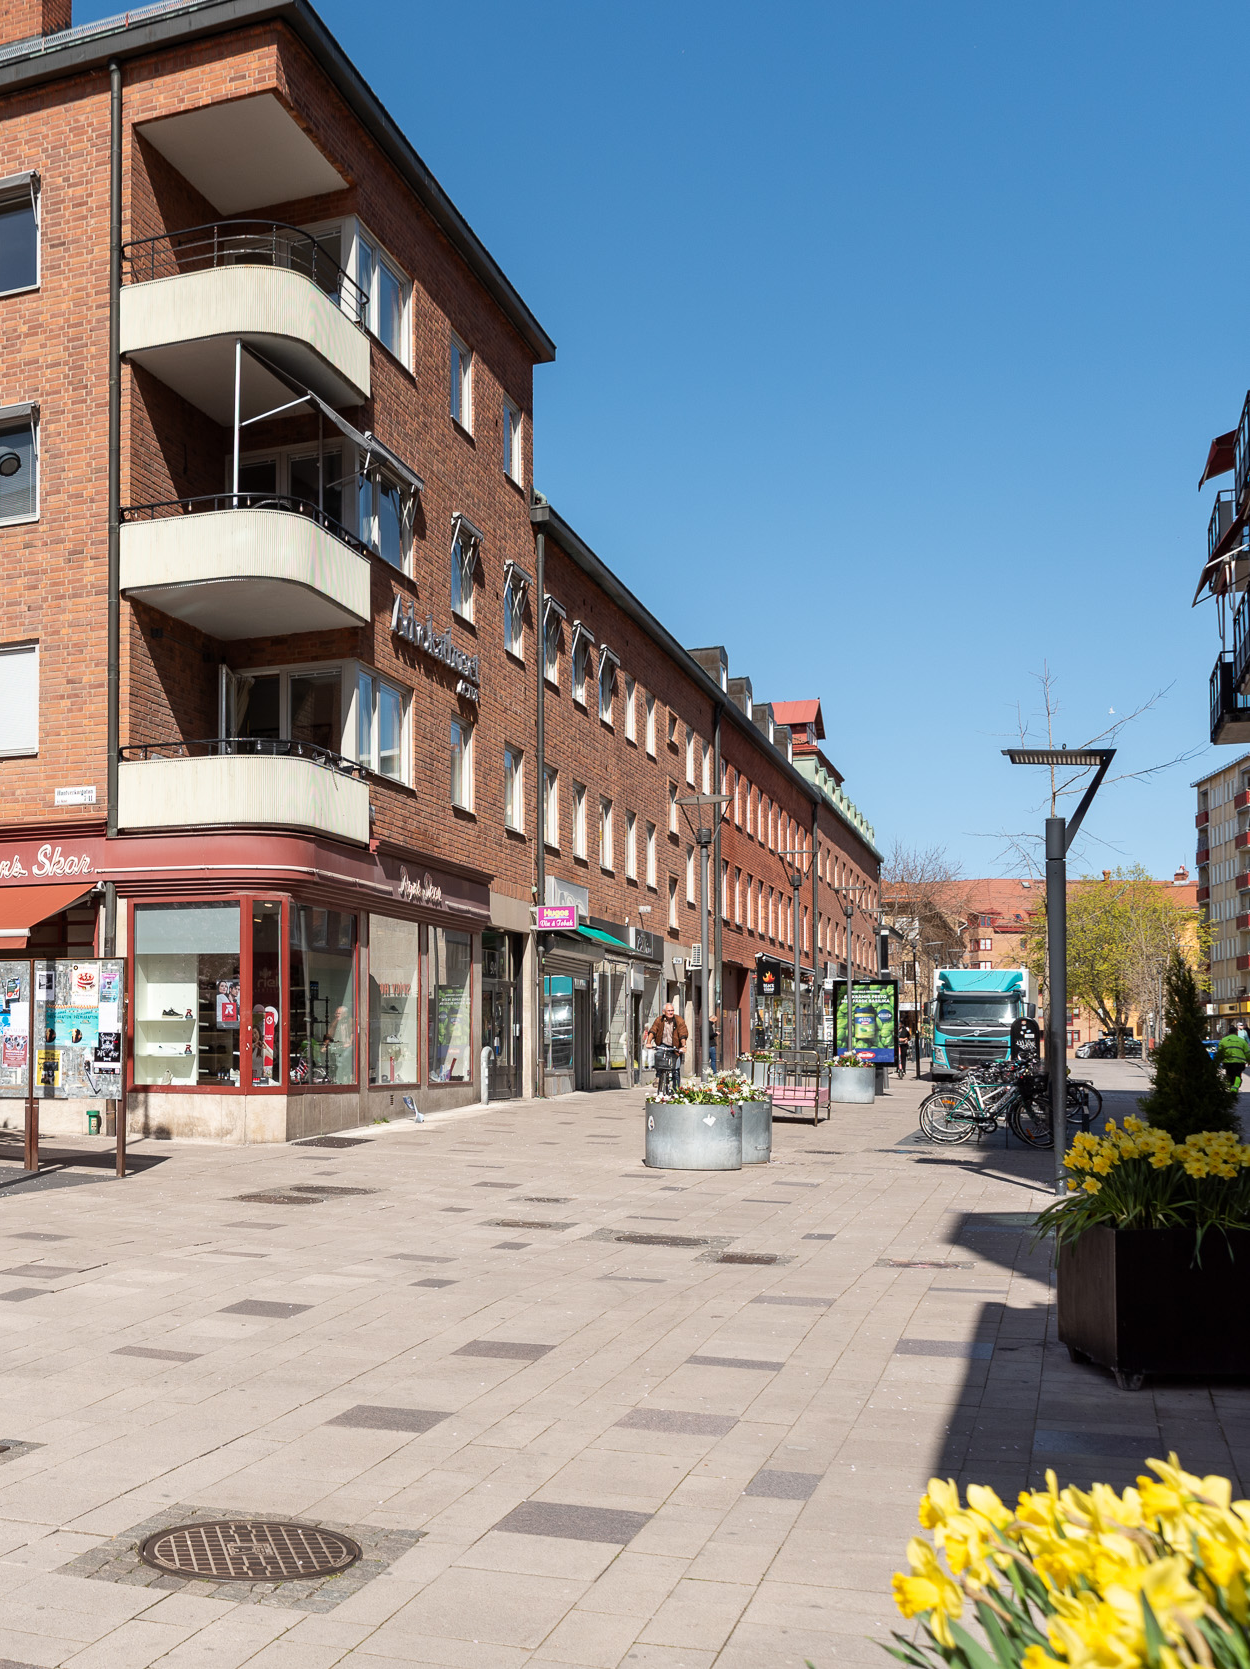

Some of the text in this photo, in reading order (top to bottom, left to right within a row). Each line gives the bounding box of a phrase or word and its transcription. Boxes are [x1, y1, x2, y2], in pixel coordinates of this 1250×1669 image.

[32, 843, 94, 877] Skor
[543, 908, 569, 918] Hugos
[555, 919, 574, 927] Tobak
